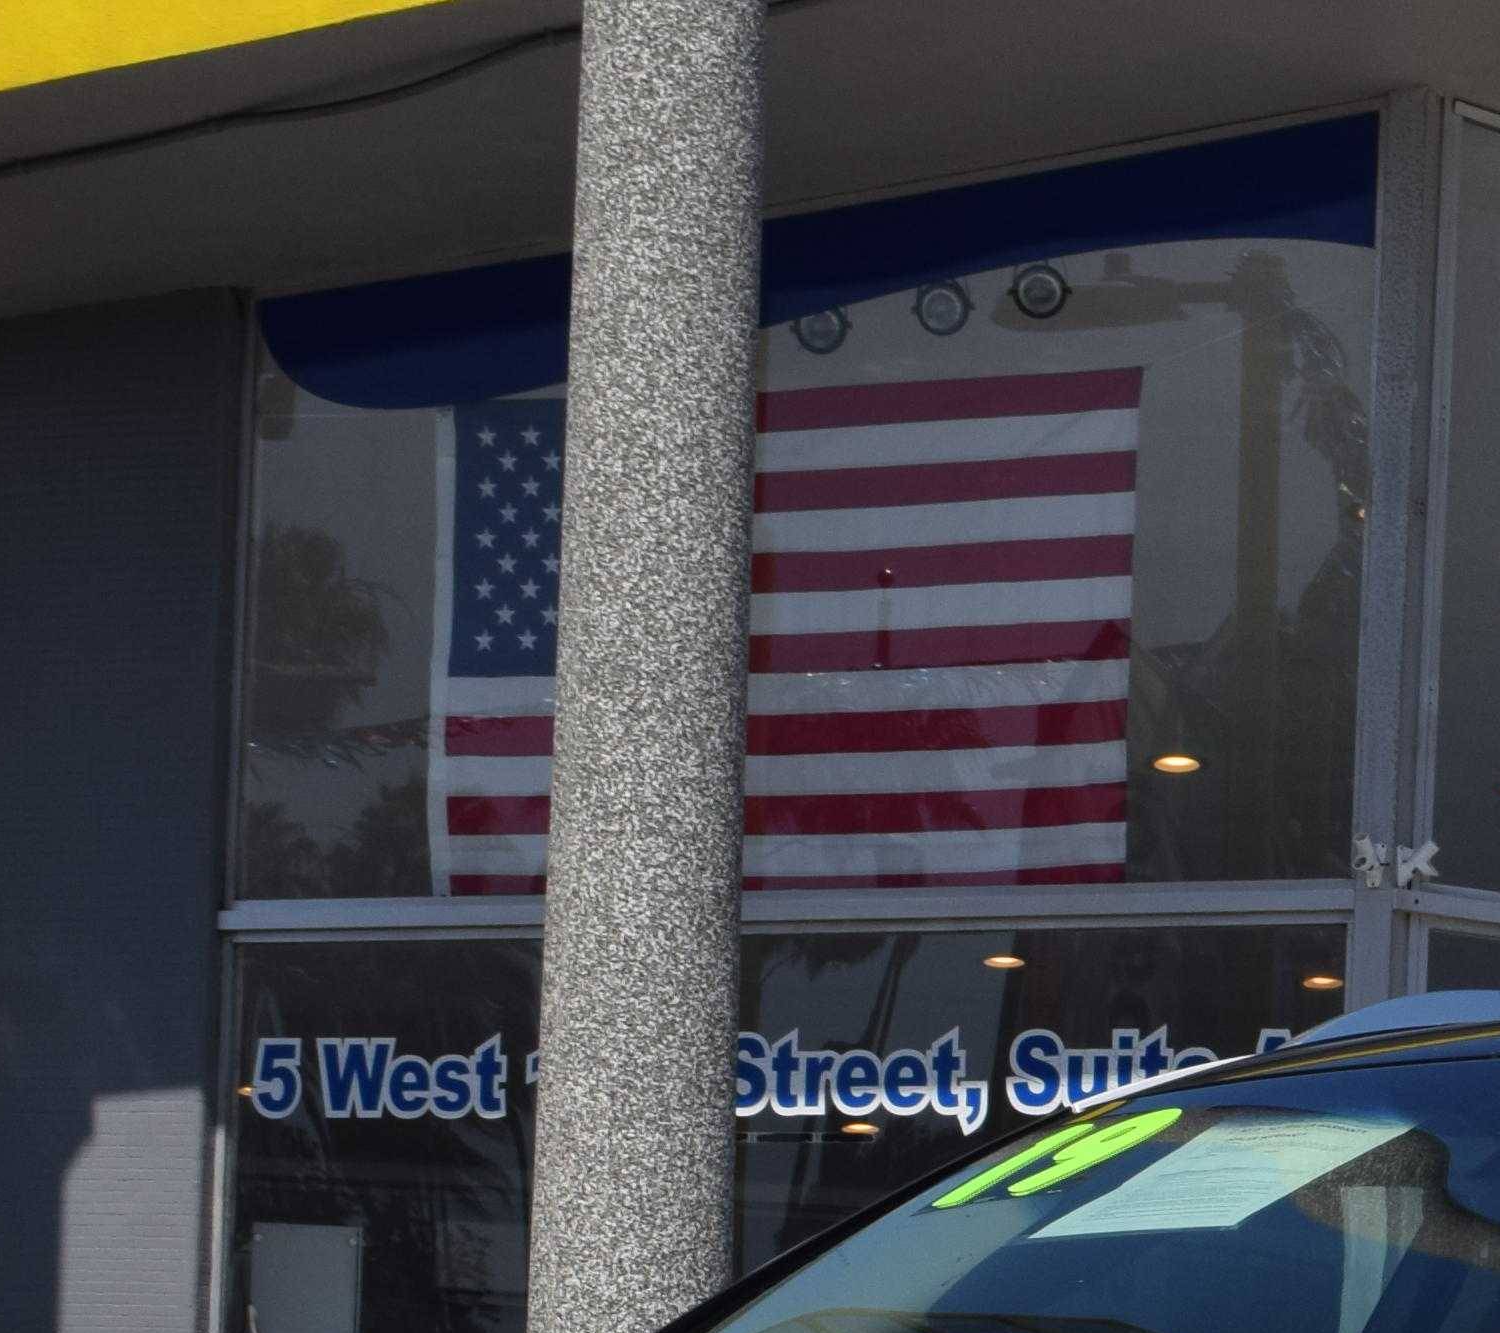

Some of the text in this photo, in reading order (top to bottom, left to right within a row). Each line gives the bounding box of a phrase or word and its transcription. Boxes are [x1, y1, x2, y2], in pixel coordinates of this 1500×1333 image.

[316, 1032, 507, 1119] West
[735, 1026, 988, 1136] Street,
[930, 1108, 1183, 1209] 19
